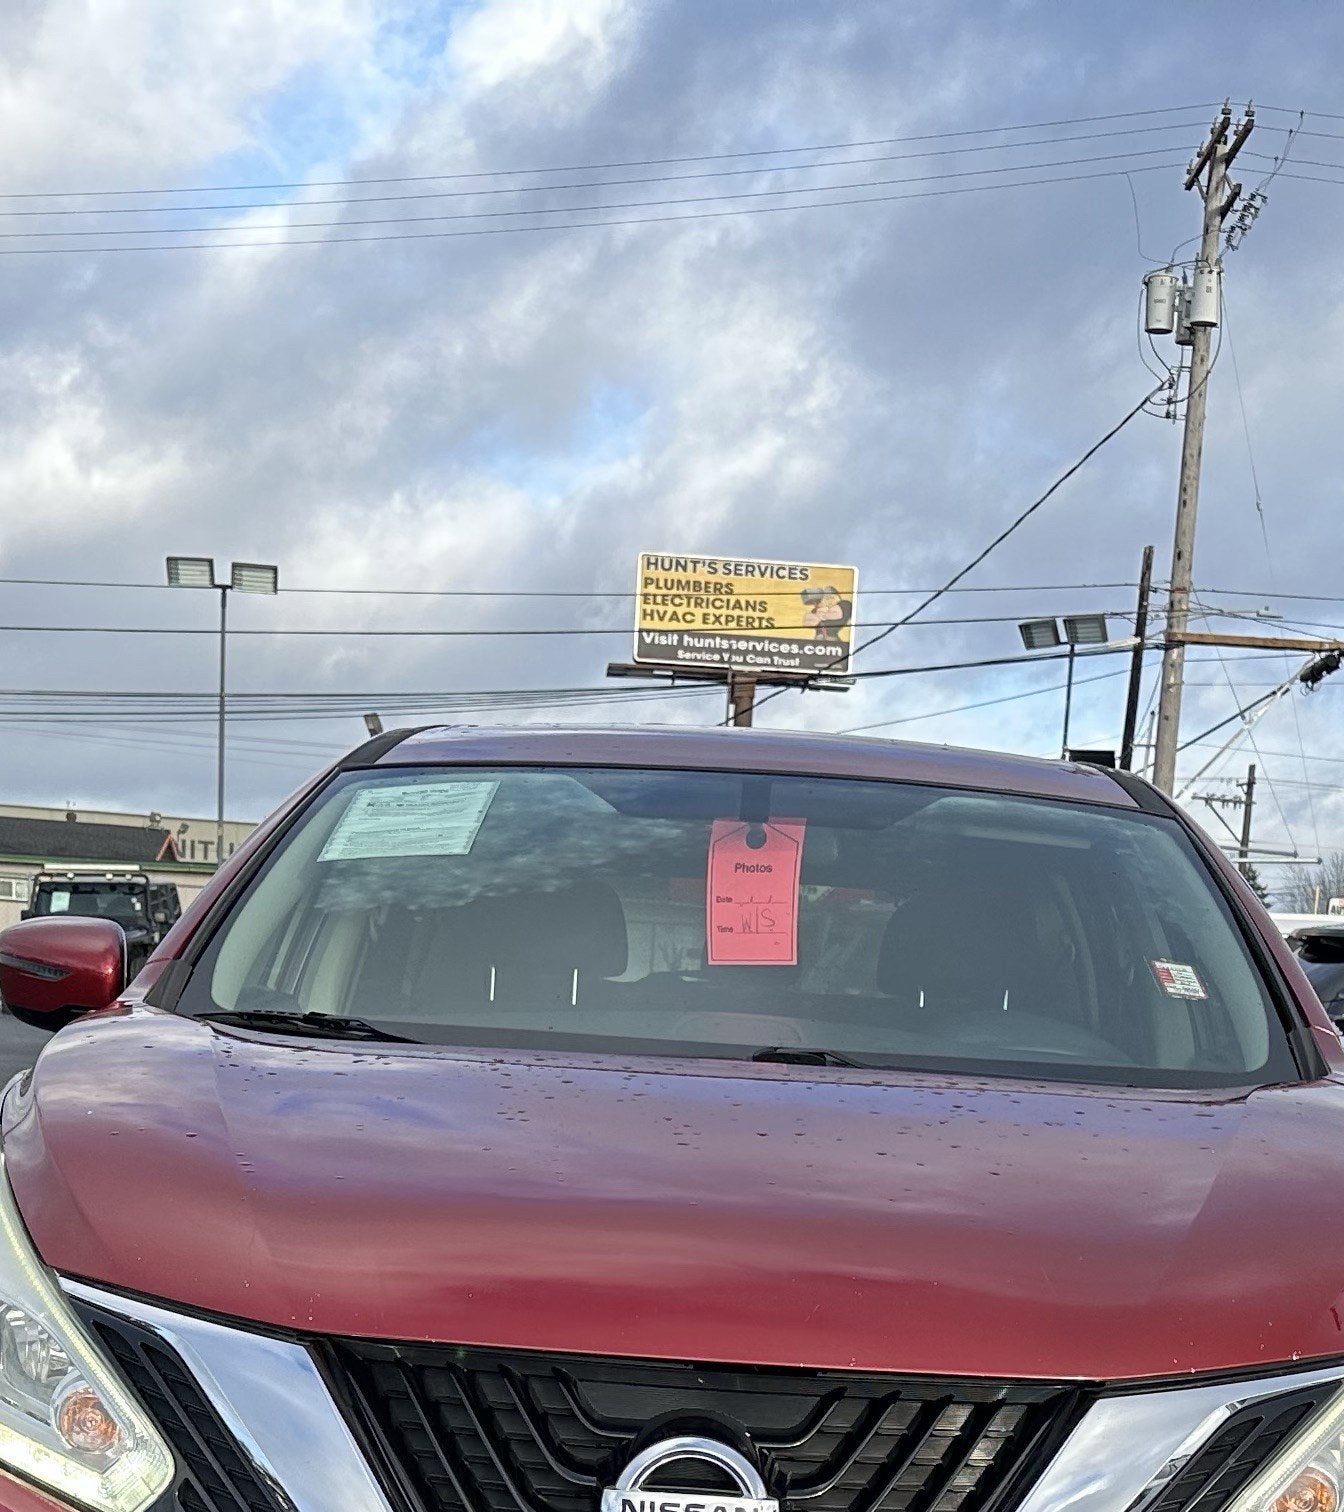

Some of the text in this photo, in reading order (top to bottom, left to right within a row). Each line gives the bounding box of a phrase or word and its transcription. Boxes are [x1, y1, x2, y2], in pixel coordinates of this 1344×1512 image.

[646, 557, 809, 581] HUNT'S SERVICES
[643, 576, 735, 595] PLUMBERS
[642, 592, 768, 613] ELECTRICIANS
[642, 608, 776, 629] HVAC EXPERTS
[642, 631, 679, 646] Visit
[677, 649, 721, 661] Service
[746, 654, 771, 664] Can
[773, 656, 800, 667] Trust
[734, 862, 773, 874] Photos
[716, 895, 733, 904] Date
